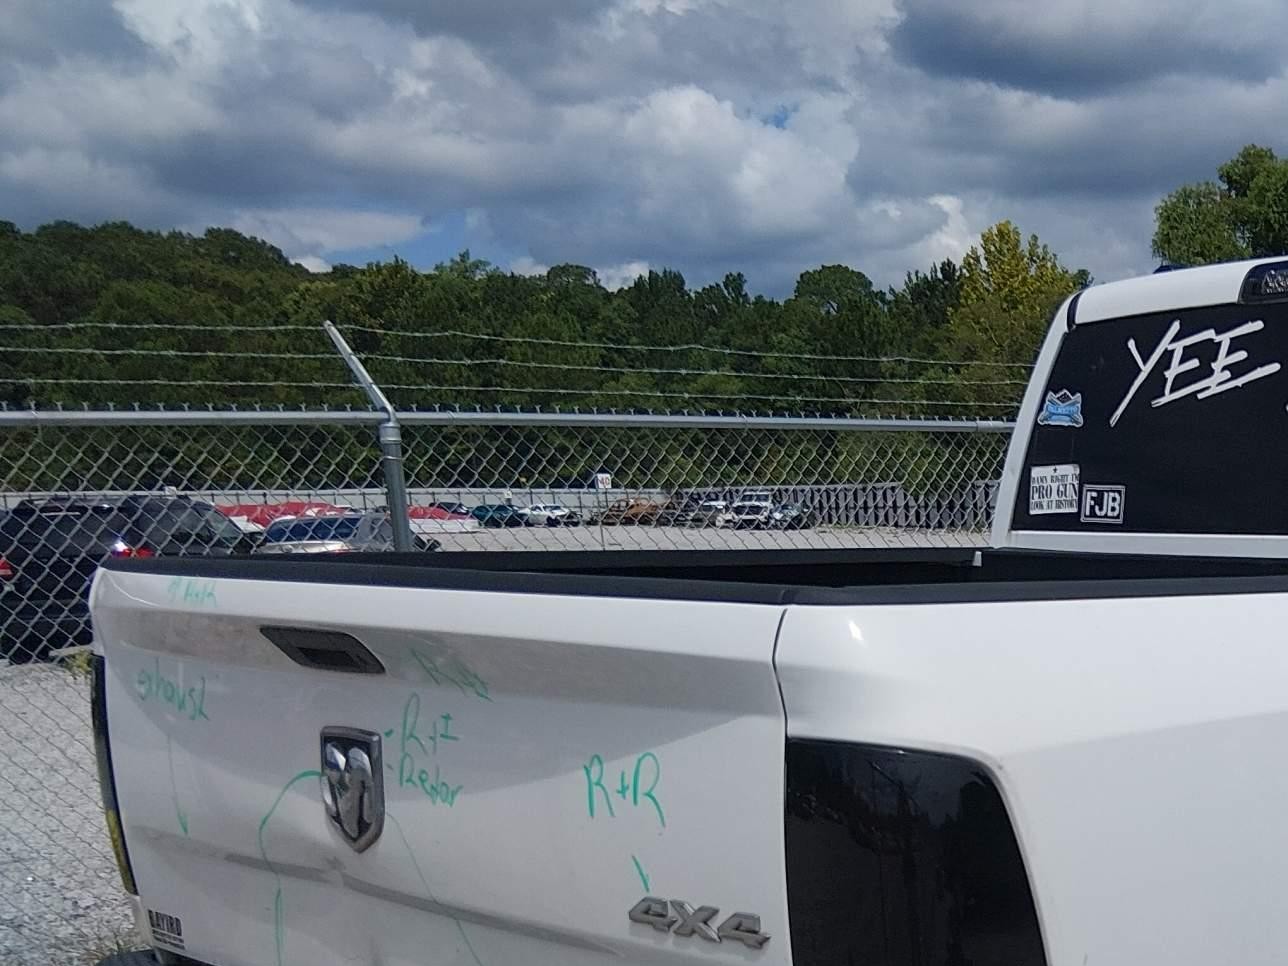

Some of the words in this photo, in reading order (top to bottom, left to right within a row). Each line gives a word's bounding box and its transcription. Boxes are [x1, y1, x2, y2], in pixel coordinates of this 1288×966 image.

[1109, 319, 1282, 428] YEE
[1031, 483, 1053, 500] PRO
[1056, 482, 1078, 499] GUN
[1085, 491, 1121, 517] FJB
